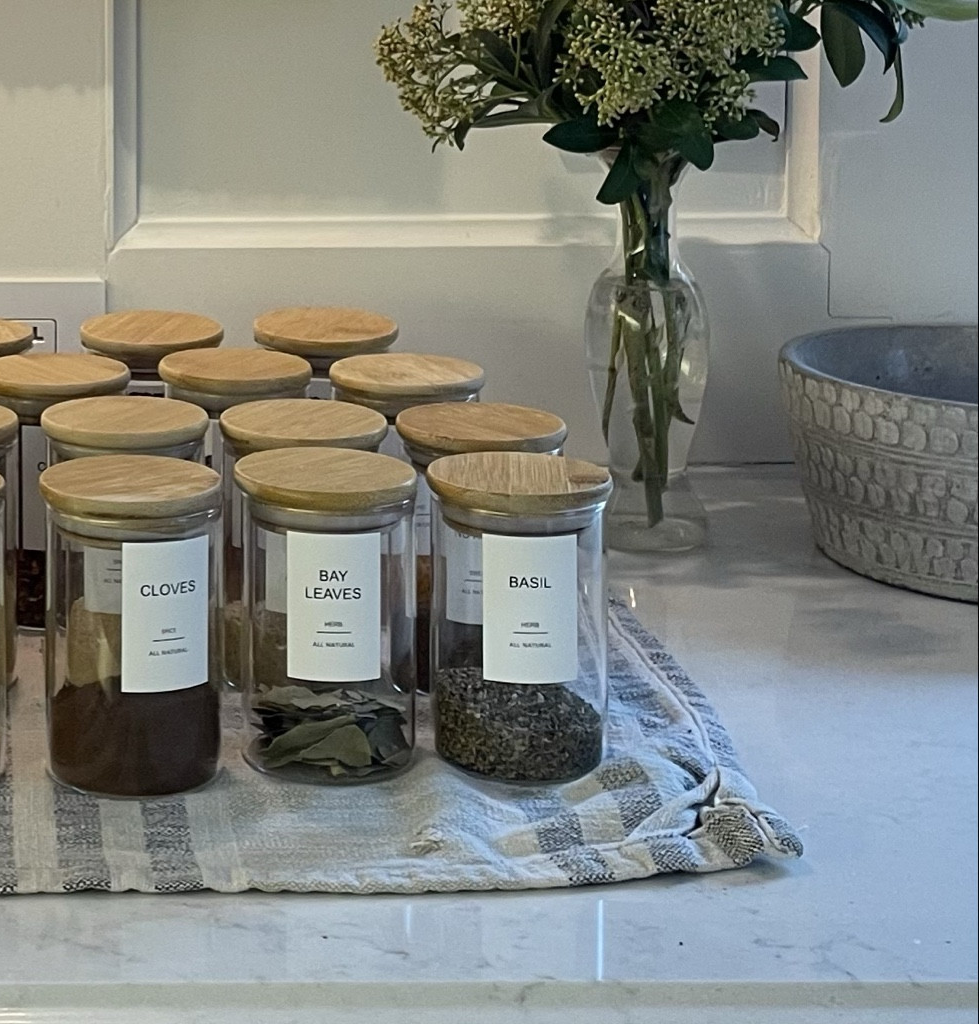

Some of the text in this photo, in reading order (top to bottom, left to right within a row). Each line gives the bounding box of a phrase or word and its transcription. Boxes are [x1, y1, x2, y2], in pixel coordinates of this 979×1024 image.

[319, 570, 348, 582] BAY
[509, 576, 552, 589] BASIL
[140, 580, 196, 597] CLOVES
[305, 587, 362, 600] LEAVES
[161, 647, 188, 655] NATURAL
